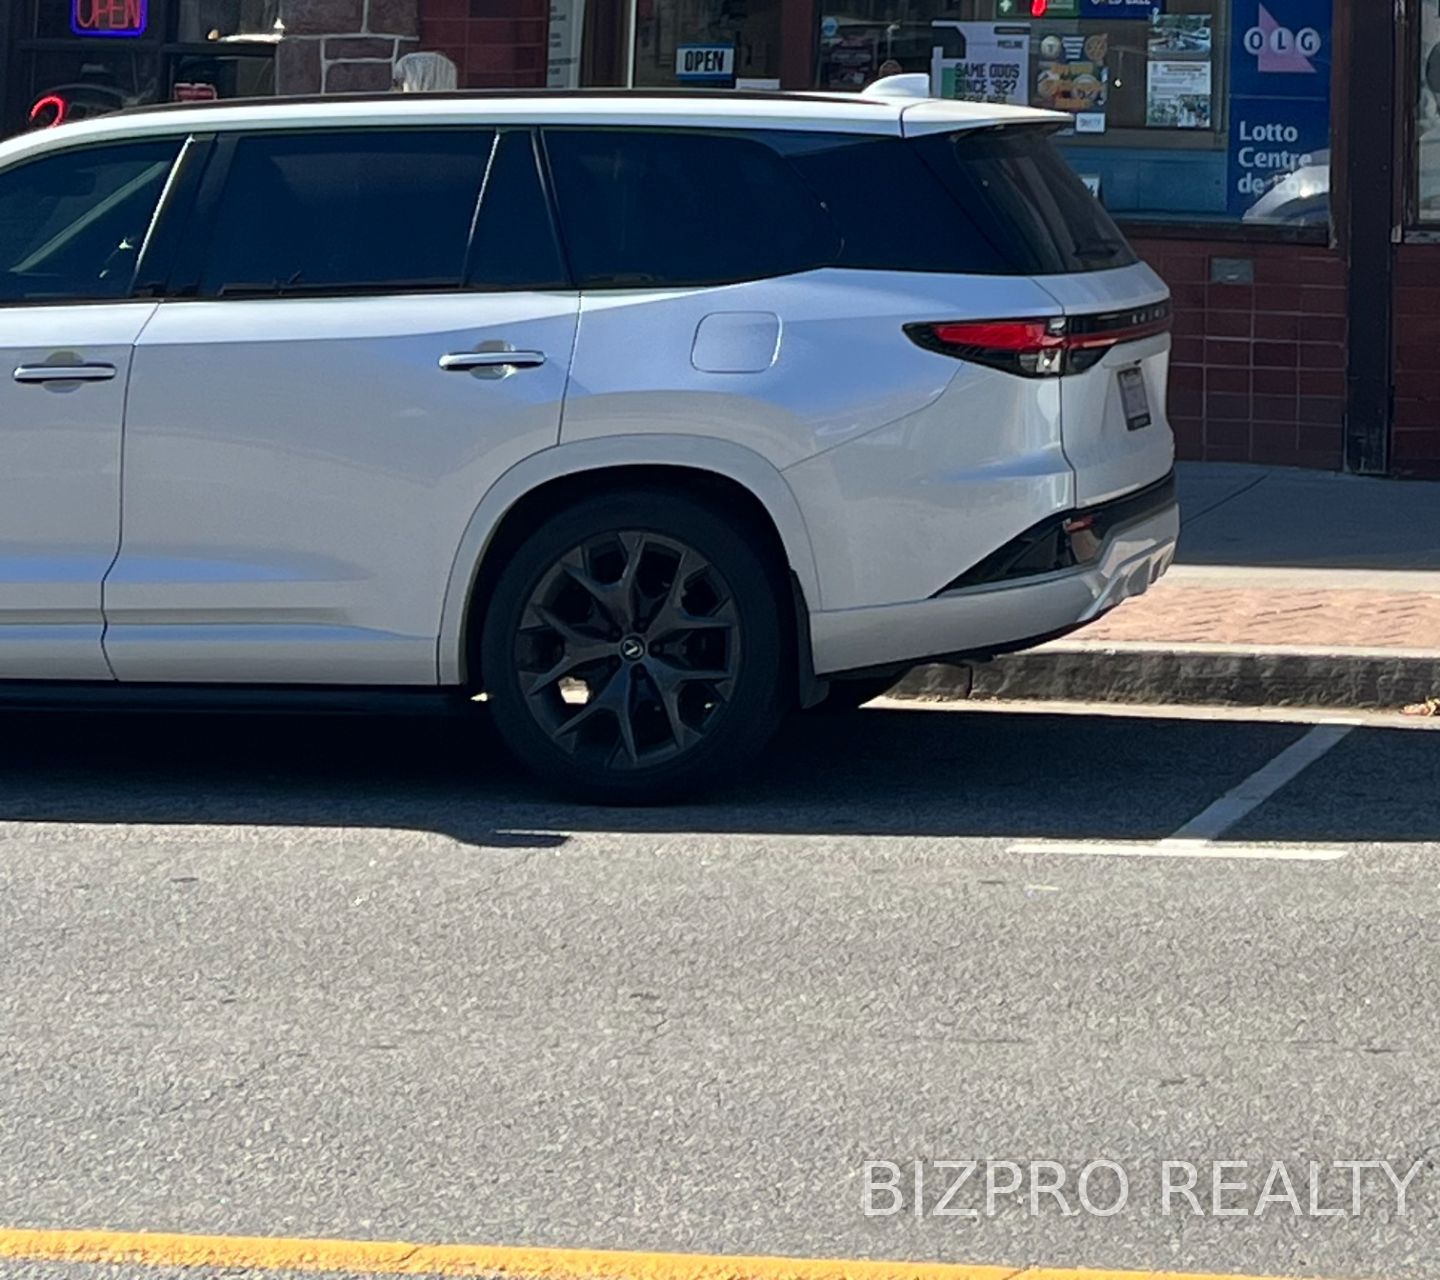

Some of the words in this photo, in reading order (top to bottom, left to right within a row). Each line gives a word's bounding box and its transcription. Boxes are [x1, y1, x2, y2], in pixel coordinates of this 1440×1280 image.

[684, 49, 725, 73] OPEN
[954, 62, 986, 78] SAME
[1239, 120, 1299, 142] Lotto
[1238, 146, 1312, 168] Centre
[1238, 172, 1265, 194] de
